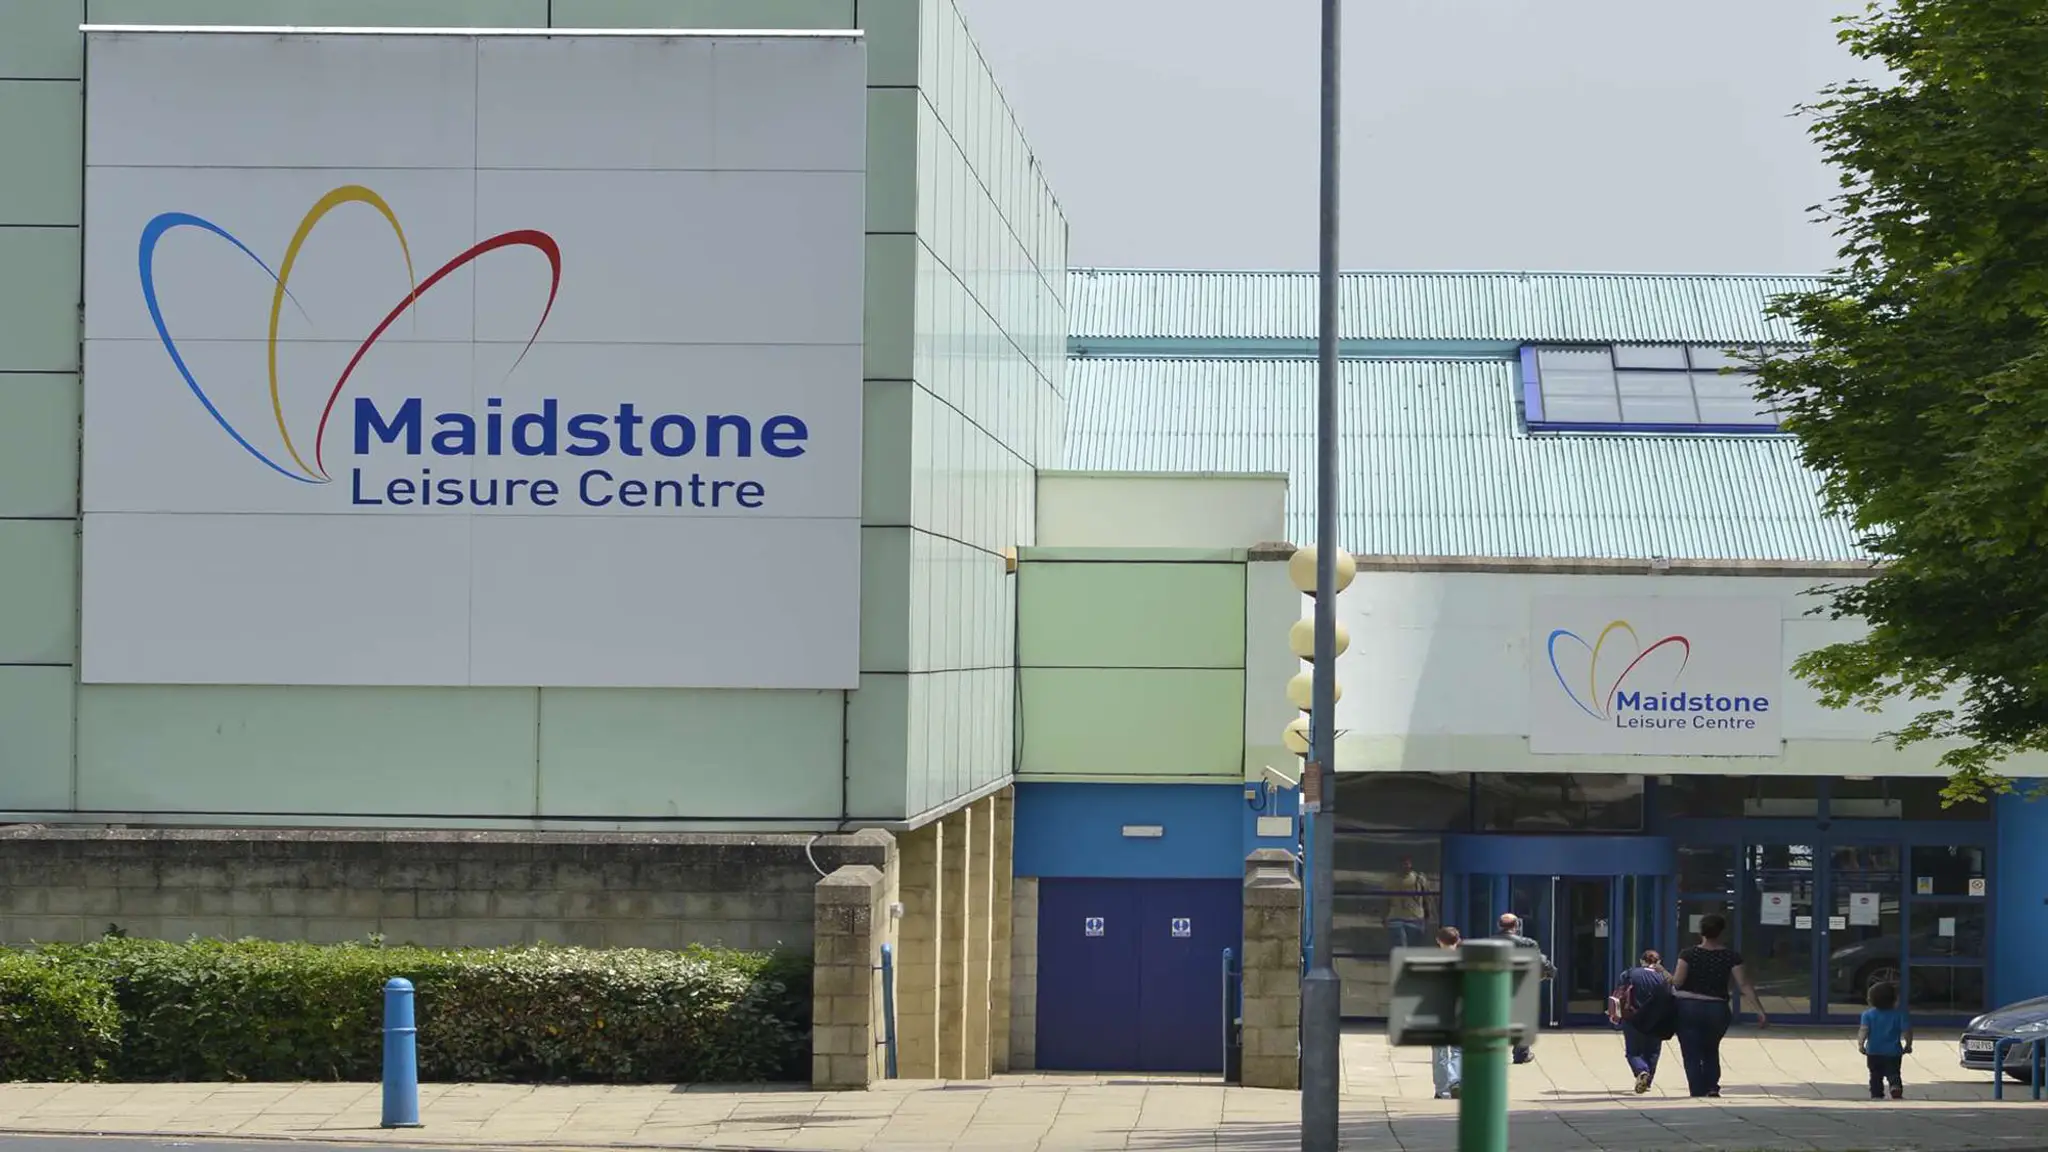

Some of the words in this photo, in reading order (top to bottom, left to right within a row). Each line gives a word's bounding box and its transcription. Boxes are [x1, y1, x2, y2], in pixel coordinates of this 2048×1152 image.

[353, 397, 809, 458] Maidstone
[352, 468, 559, 506] Leisure
[579, 469, 765, 508] Centre
[1616, 691, 1769, 712] Maidstone
[1616, 715, 1686, 729] Leisure
[1692, 715, 1756, 729] Centre
